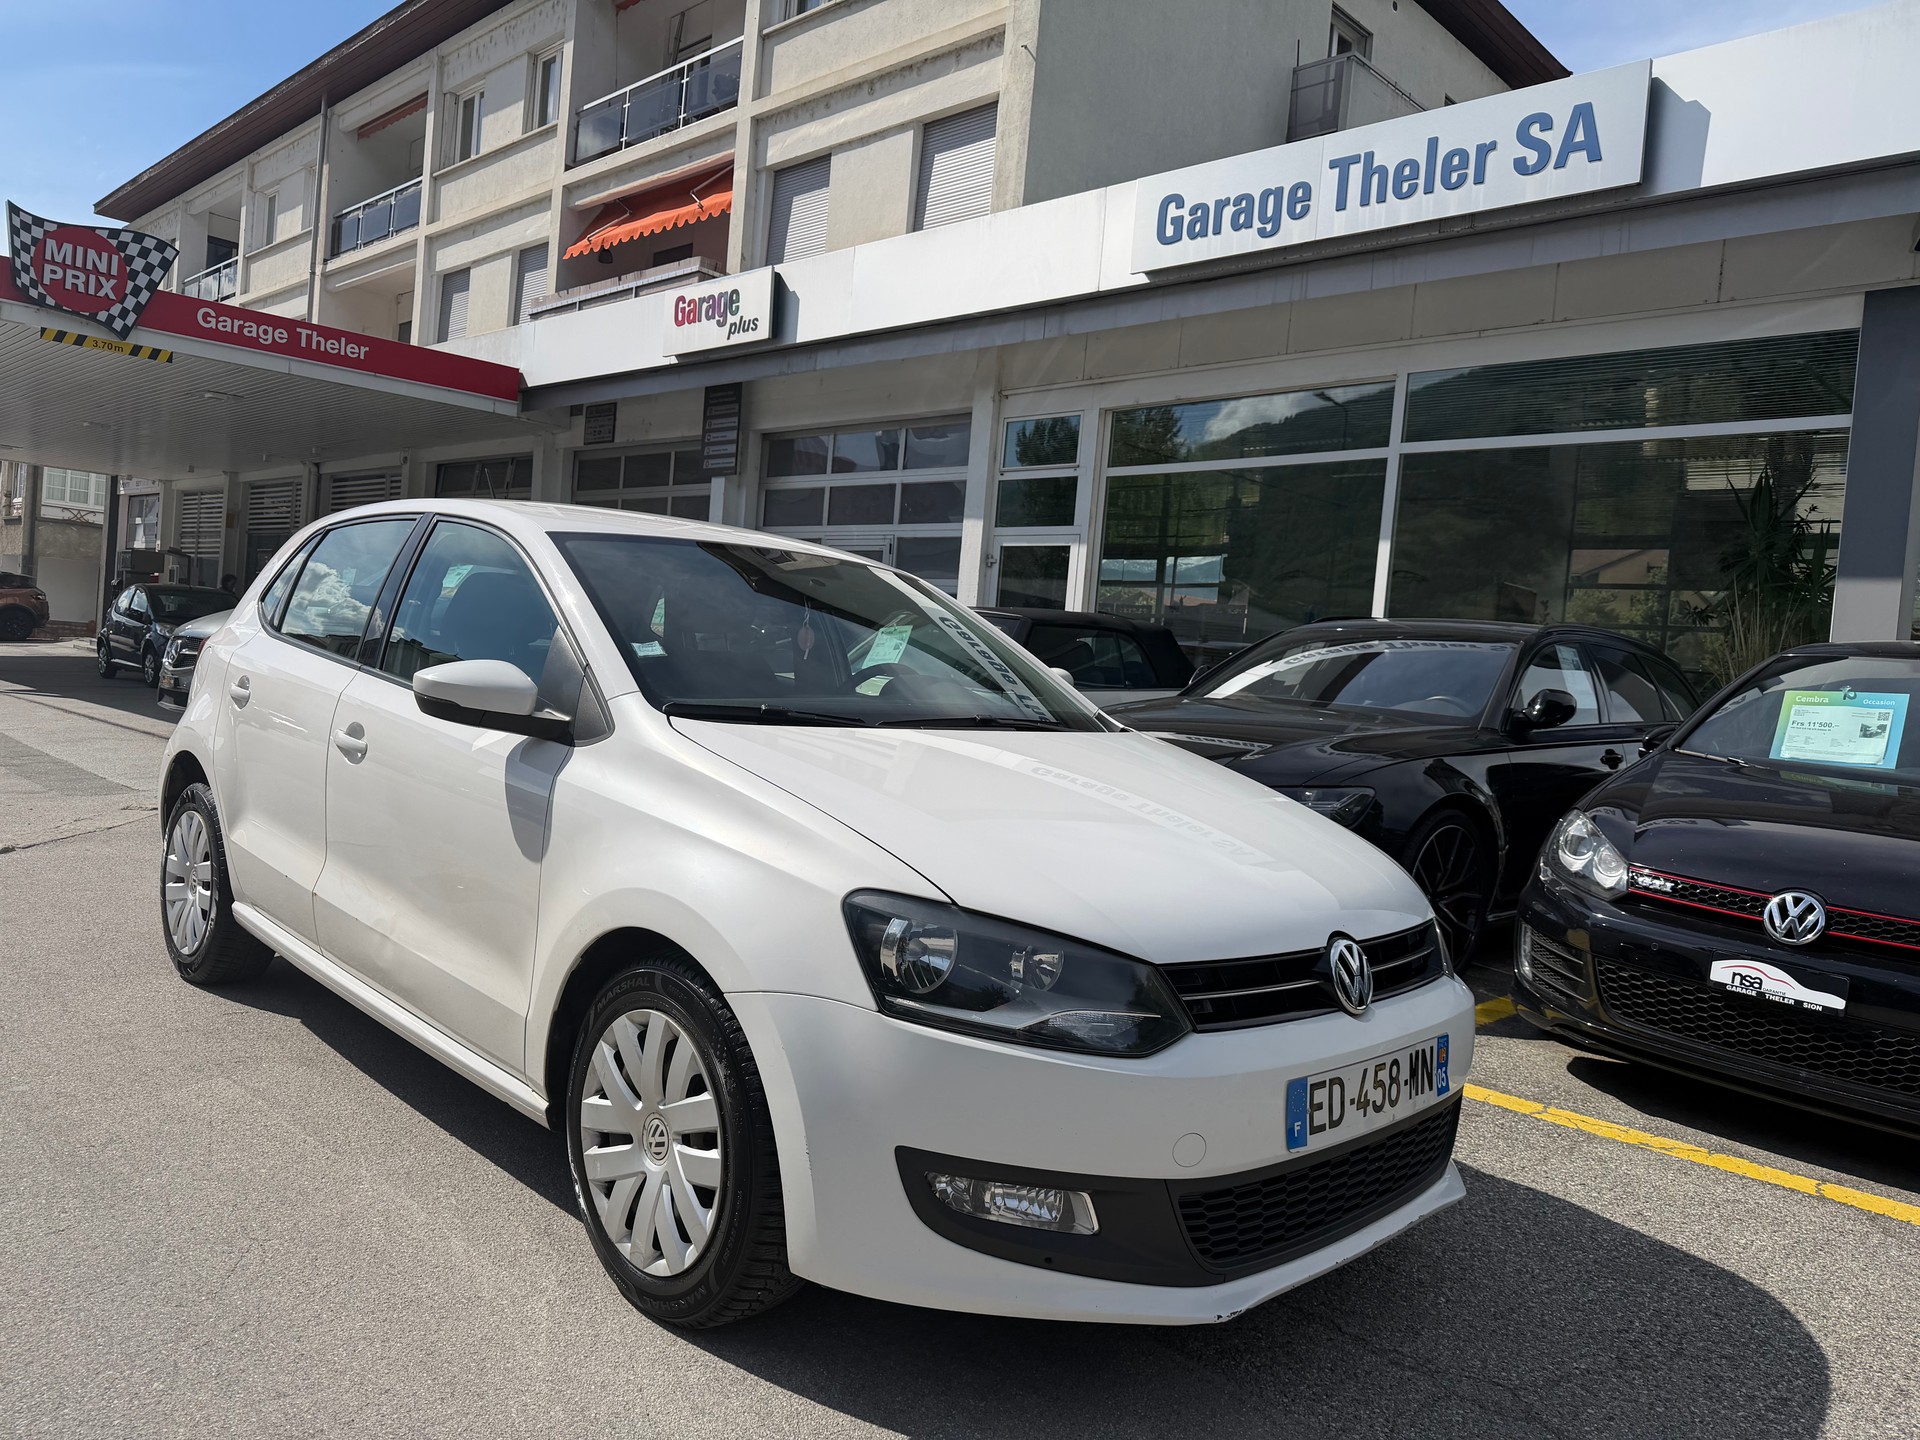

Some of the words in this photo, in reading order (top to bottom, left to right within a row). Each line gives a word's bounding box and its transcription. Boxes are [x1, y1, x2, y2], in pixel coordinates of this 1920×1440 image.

[1156, 180, 1312, 246] Garage
[1328, 135, 1498, 211] Theler
[1512, 101, 1603, 176] SA
[43, 238, 119, 277] MINI
[42, 264, 117, 300] PRIX
[674, 288, 741, 327] Garage
[196, 308, 289, 346] Garage
[296, 327, 370, 361] Theler
[726, 315, 760, 340] plus
[1795, 695, 1829, 703] Cembra
[1863, 698, 1896, 706] Occasion
[1764, 892, 1826, 945] VW
[597, 977, 650, 1012] MARSHAL
[1726, 984, 1757, 997] GARAGE
[1765, 993, 1795, 1005] THELER
[1803, 1002, 1823, 1011] SION
[1731, 971, 1764, 990] nsa
[1309, 1045, 1434, 1136] ED-458-MN
[1437, 1066, 1446, 1089] 05
[1294, 1121, 1302, 1137] F
